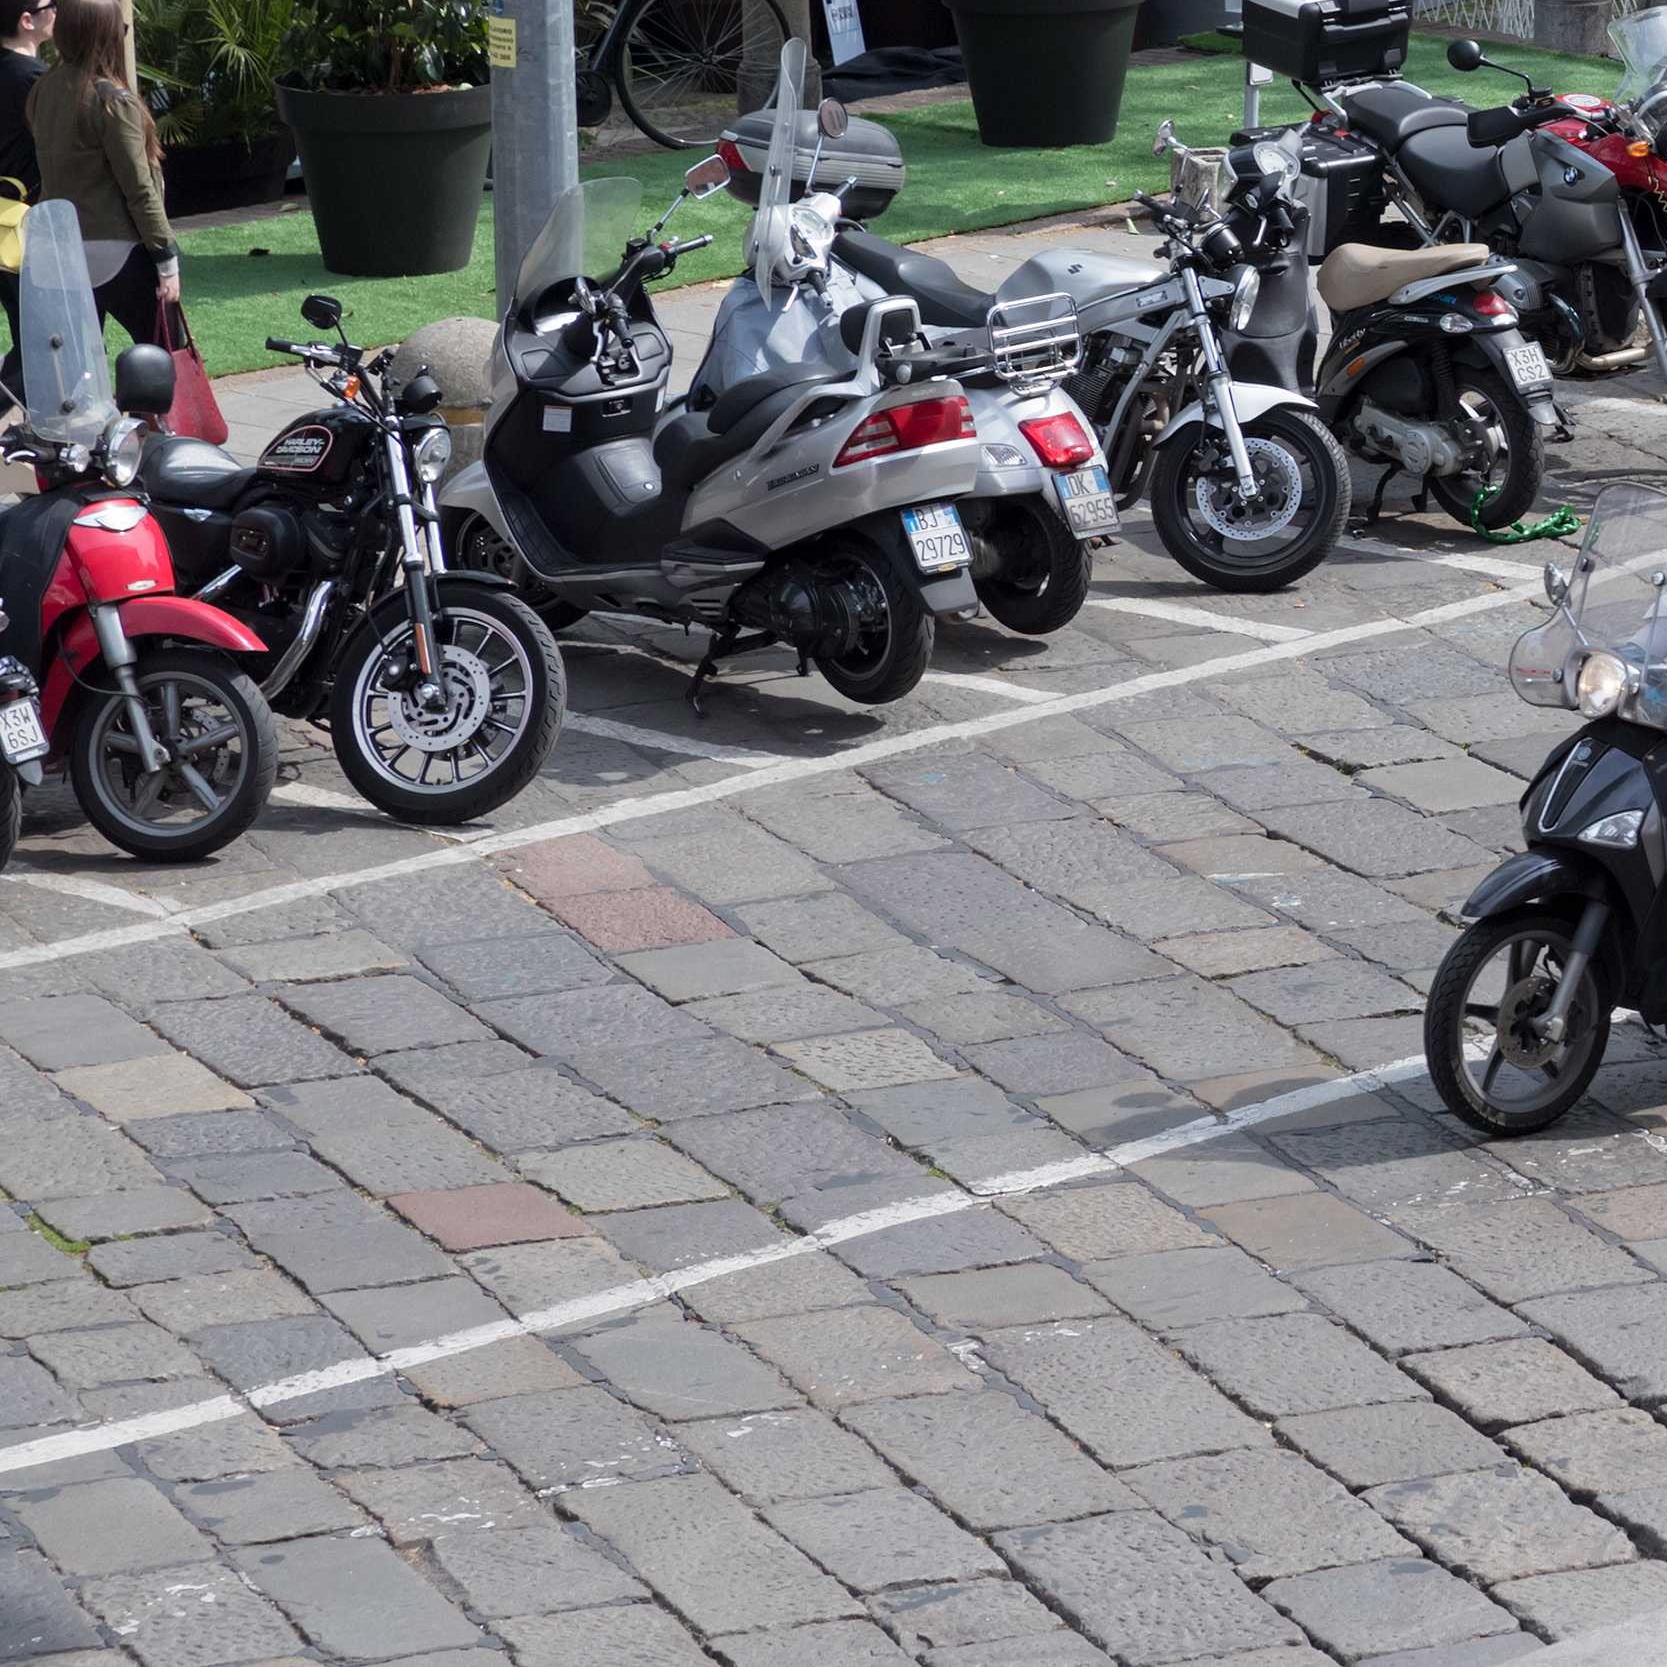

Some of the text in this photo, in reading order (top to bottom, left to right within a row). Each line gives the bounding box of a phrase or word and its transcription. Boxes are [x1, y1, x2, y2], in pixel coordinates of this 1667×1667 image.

[1511, 346, 1540, 368] X3H
[1516, 363, 1545, 383] CS2
[1068, 473, 1090, 497] DK
[916, 508, 939, 531] BJ
[1069, 497, 1115, 528] 62955
[916, 532, 966, 563] 29729
[8, 725, 39, 750] 6SJ
